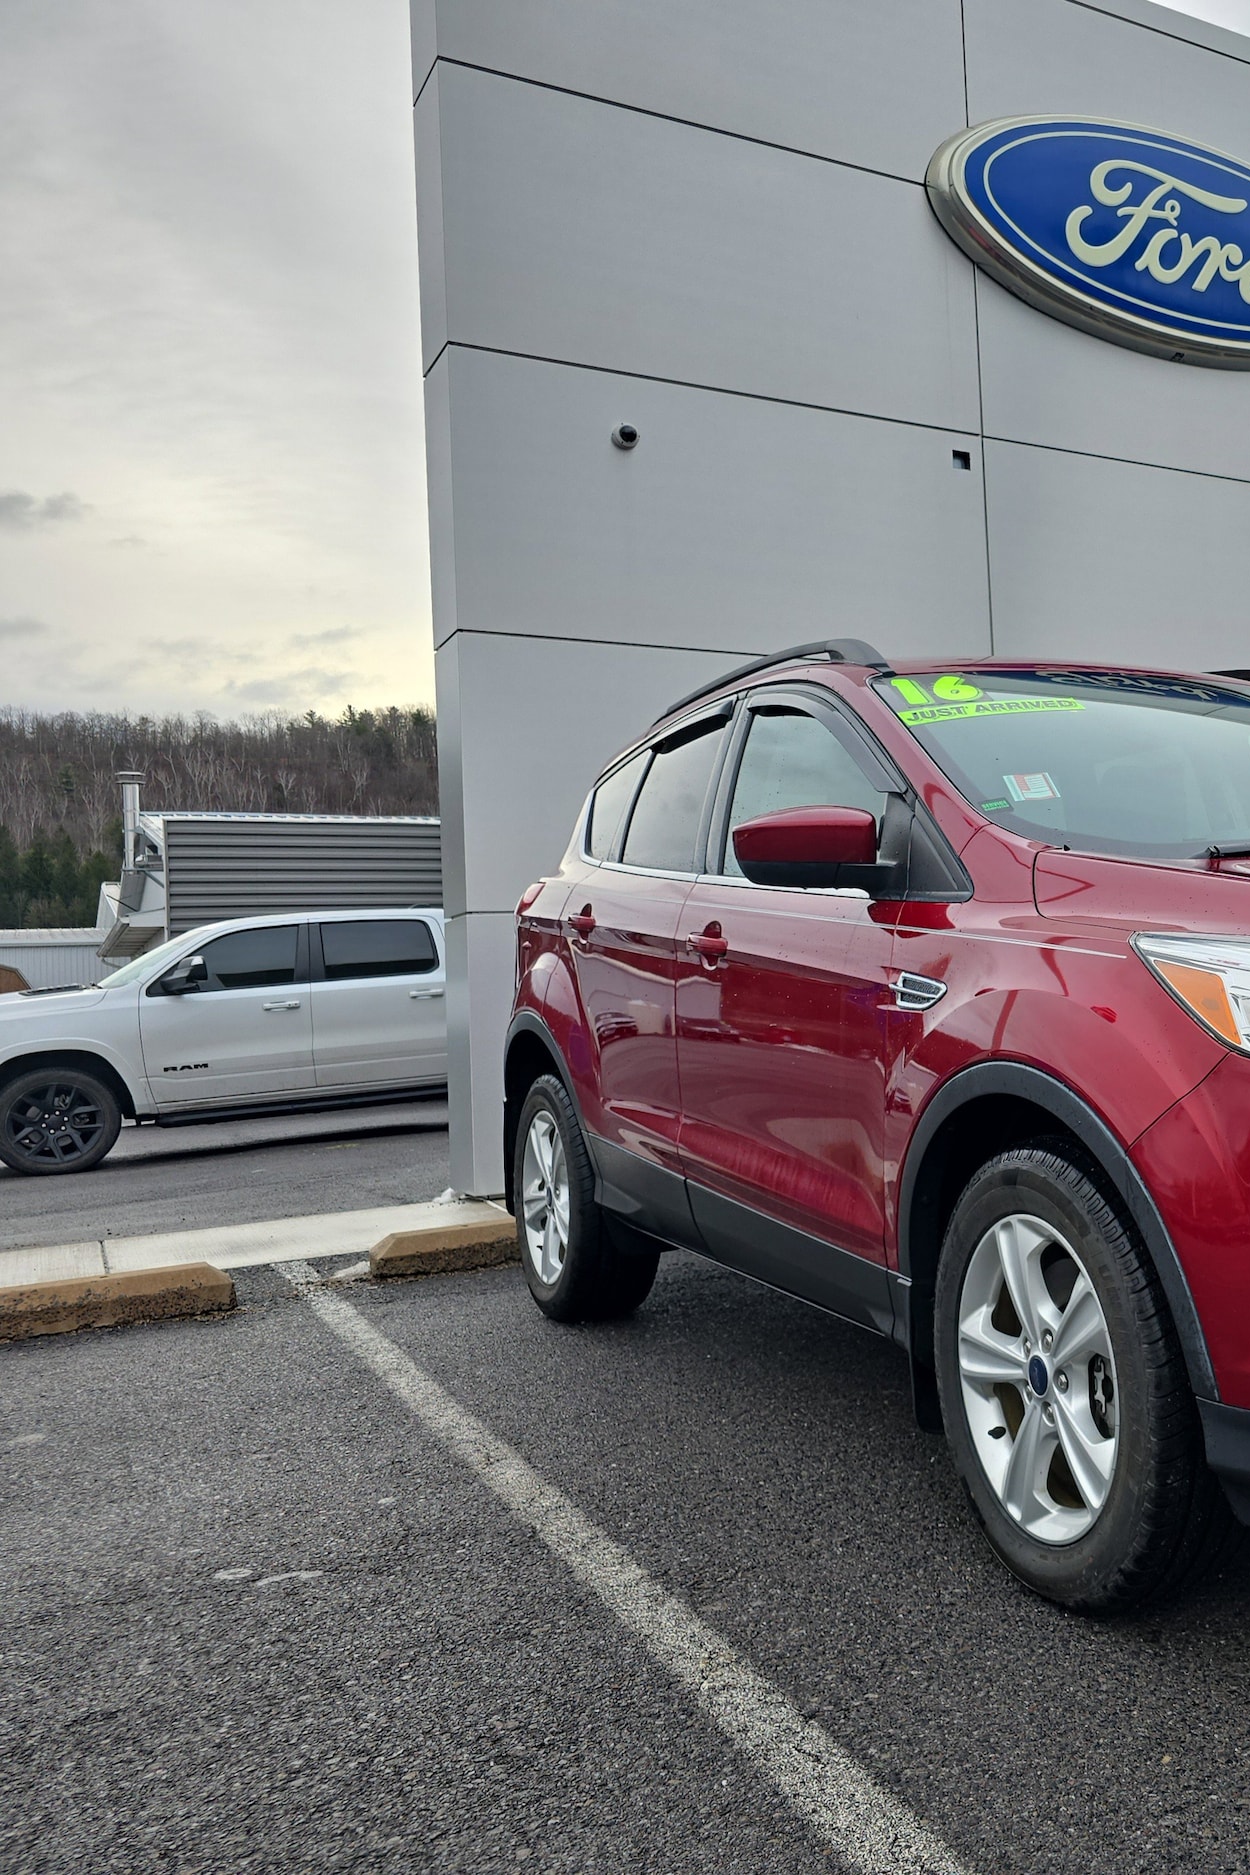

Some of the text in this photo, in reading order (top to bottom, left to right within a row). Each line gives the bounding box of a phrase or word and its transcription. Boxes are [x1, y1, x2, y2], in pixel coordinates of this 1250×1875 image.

[890, 675, 984, 706] 16
[906, 698, 1076, 722] JUST ARRIVED
[163, 1063, 208, 1072] RAM
